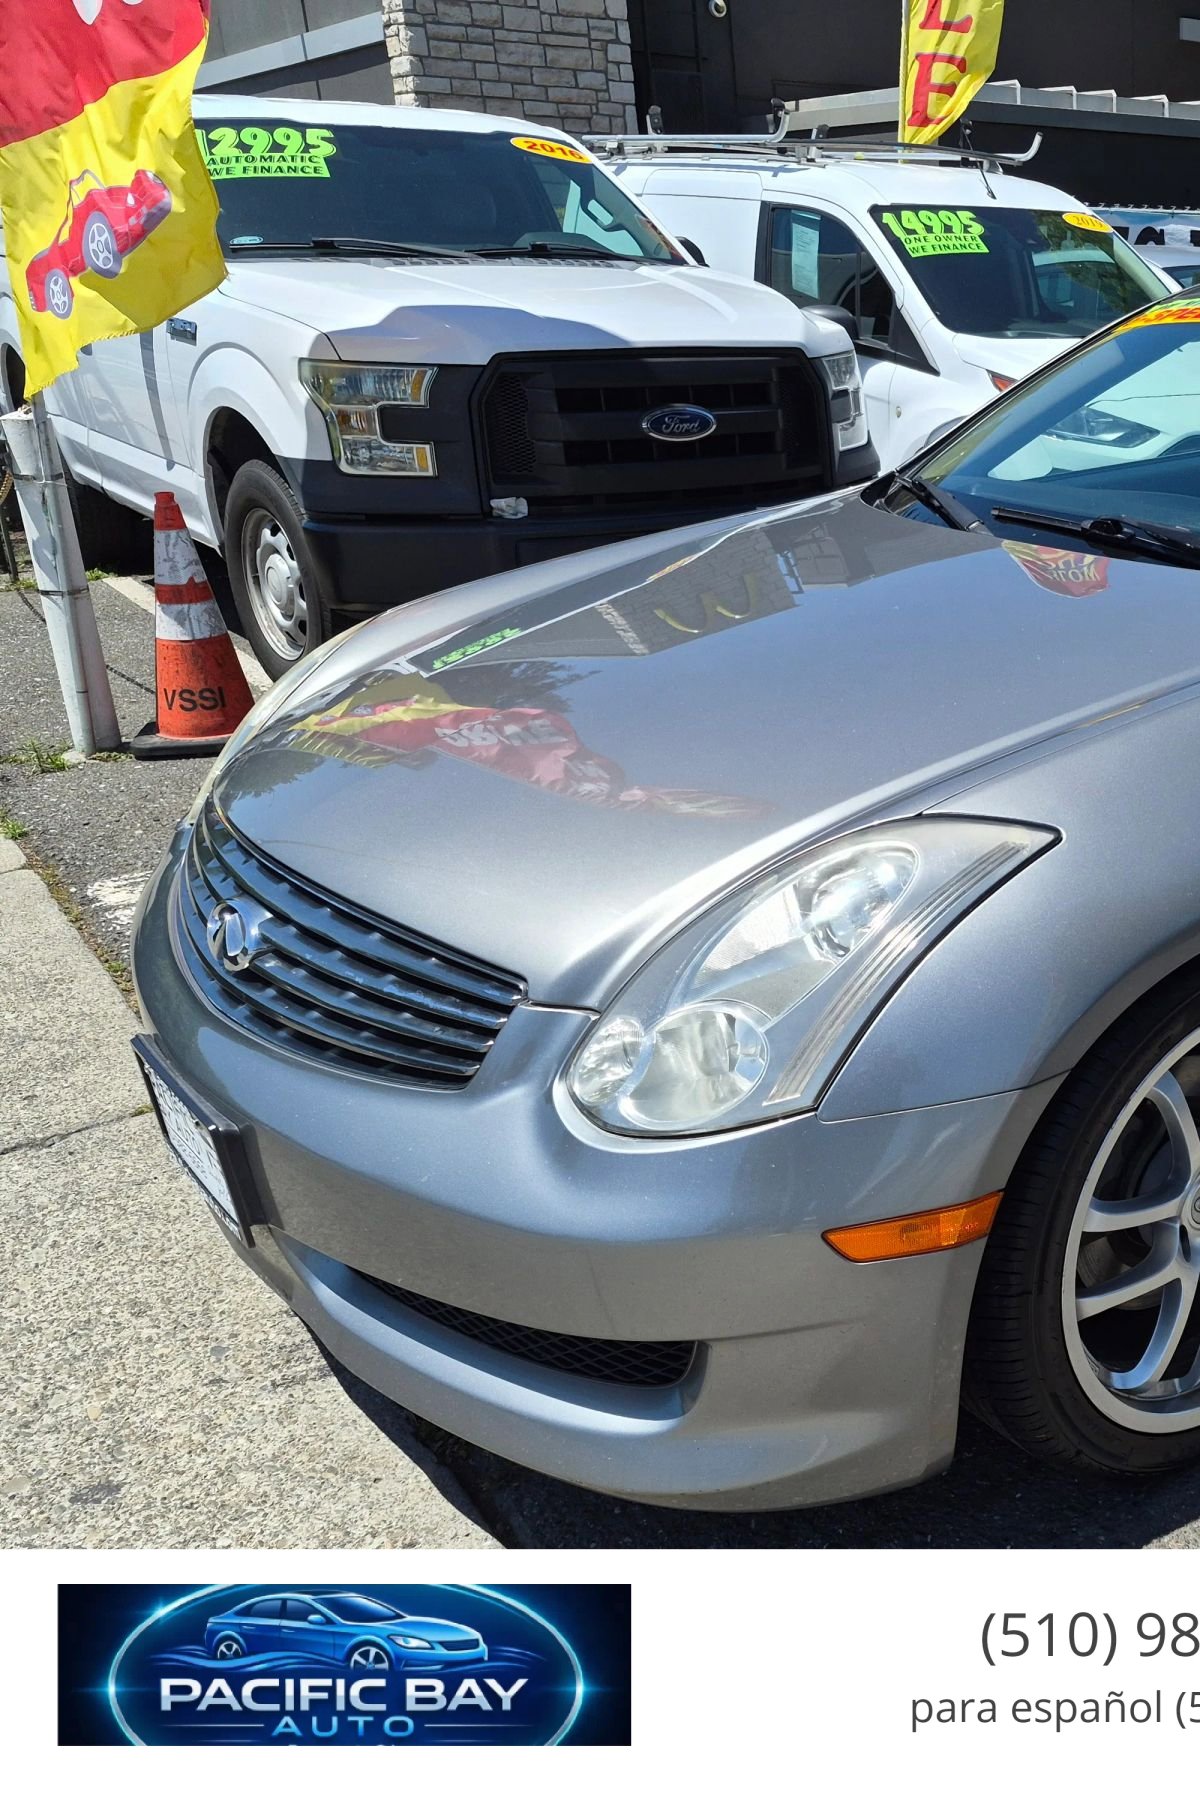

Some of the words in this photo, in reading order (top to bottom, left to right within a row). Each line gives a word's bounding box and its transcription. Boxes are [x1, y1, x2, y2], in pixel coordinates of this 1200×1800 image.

[523, 140, 586, 160] 2016
[207, 155, 321, 166] AUTOMATIC
[208, 166, 236, 176] WE
[242, 165, 324, 175] FINANCE
[882, 210, 985, 238] 14995
[904, 234, 932, 246] ONE
[934, 233, 979, 244] OWNER
[908, 244, 929, 255] WE
[932, 242, 984, 253] FINANCE
[662, 414, 701, 434] Ford
[163, 685, 227, 712] VSSI
